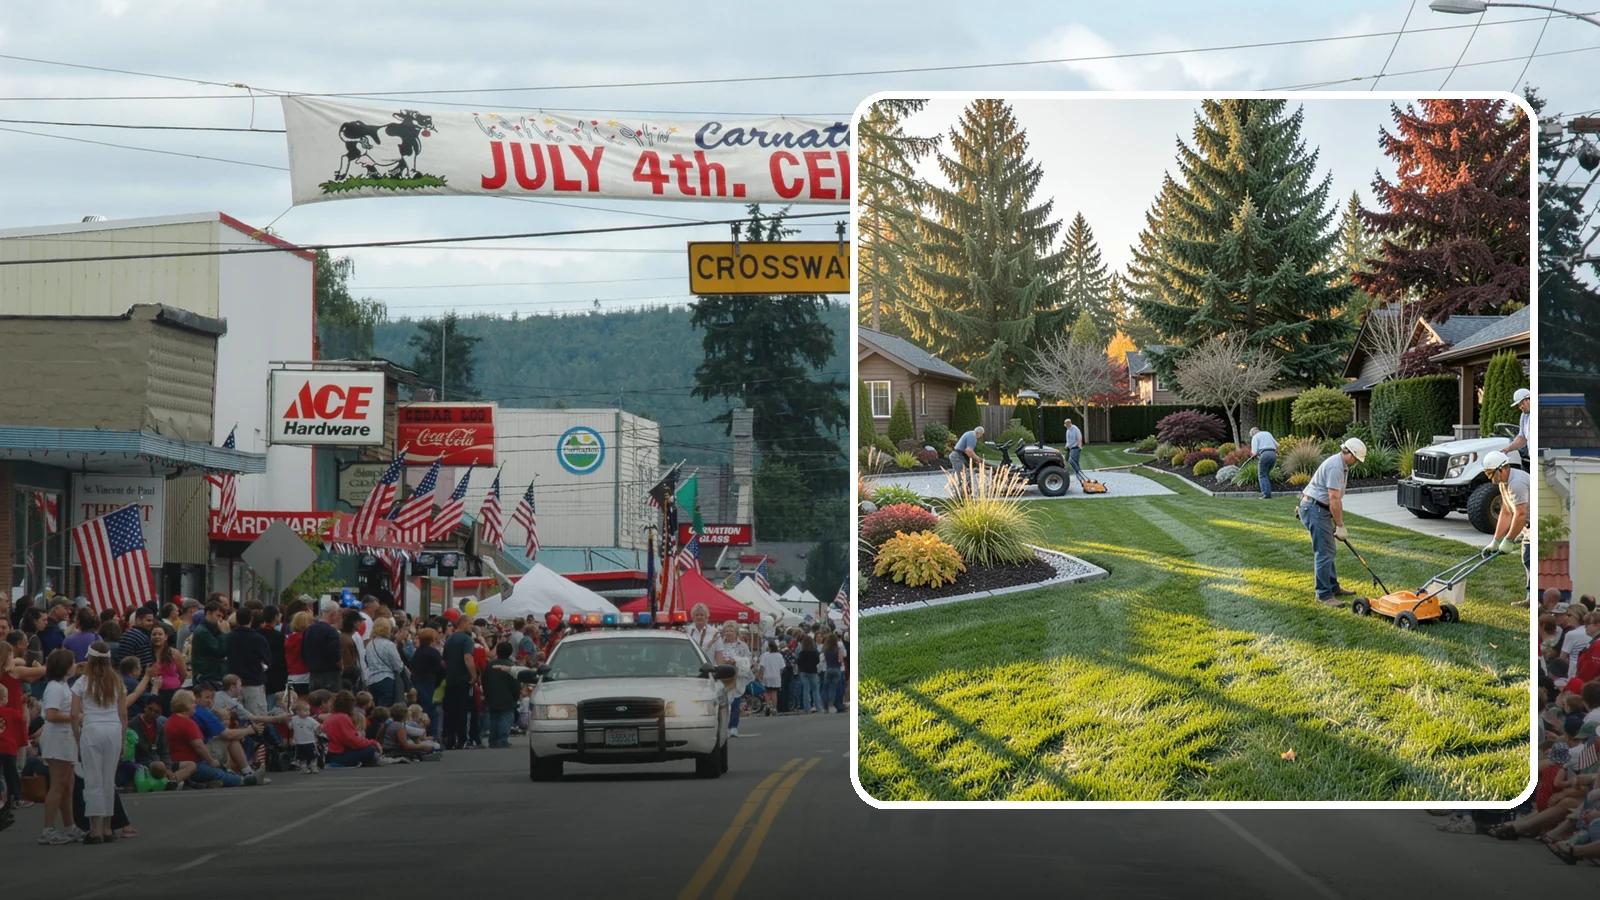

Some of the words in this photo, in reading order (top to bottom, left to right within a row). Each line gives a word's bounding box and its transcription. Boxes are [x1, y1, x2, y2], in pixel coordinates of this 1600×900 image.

[695, 121, 850, 150] Carnat
[481, 141, 605, 193] JULY
[632, 150, 746, 198] 4th.
[283, 380, 374, 420] ACE
[406, 409, 452, 421] CEDAR
[284, 421, 371, 436] Hardware
[416, 428, 477, 447] Coca-Cola
[353, 467, 386, 481] Simpl
[95, 484, 124, 495] Vincent
[126, 485, 136, 495] de
[137, 485, 155, 496] Paul
[81, 503, 154, 522] THT
[688, 526, 741, 535] CRNATION
[699, 535, 730, 543] GLASS
